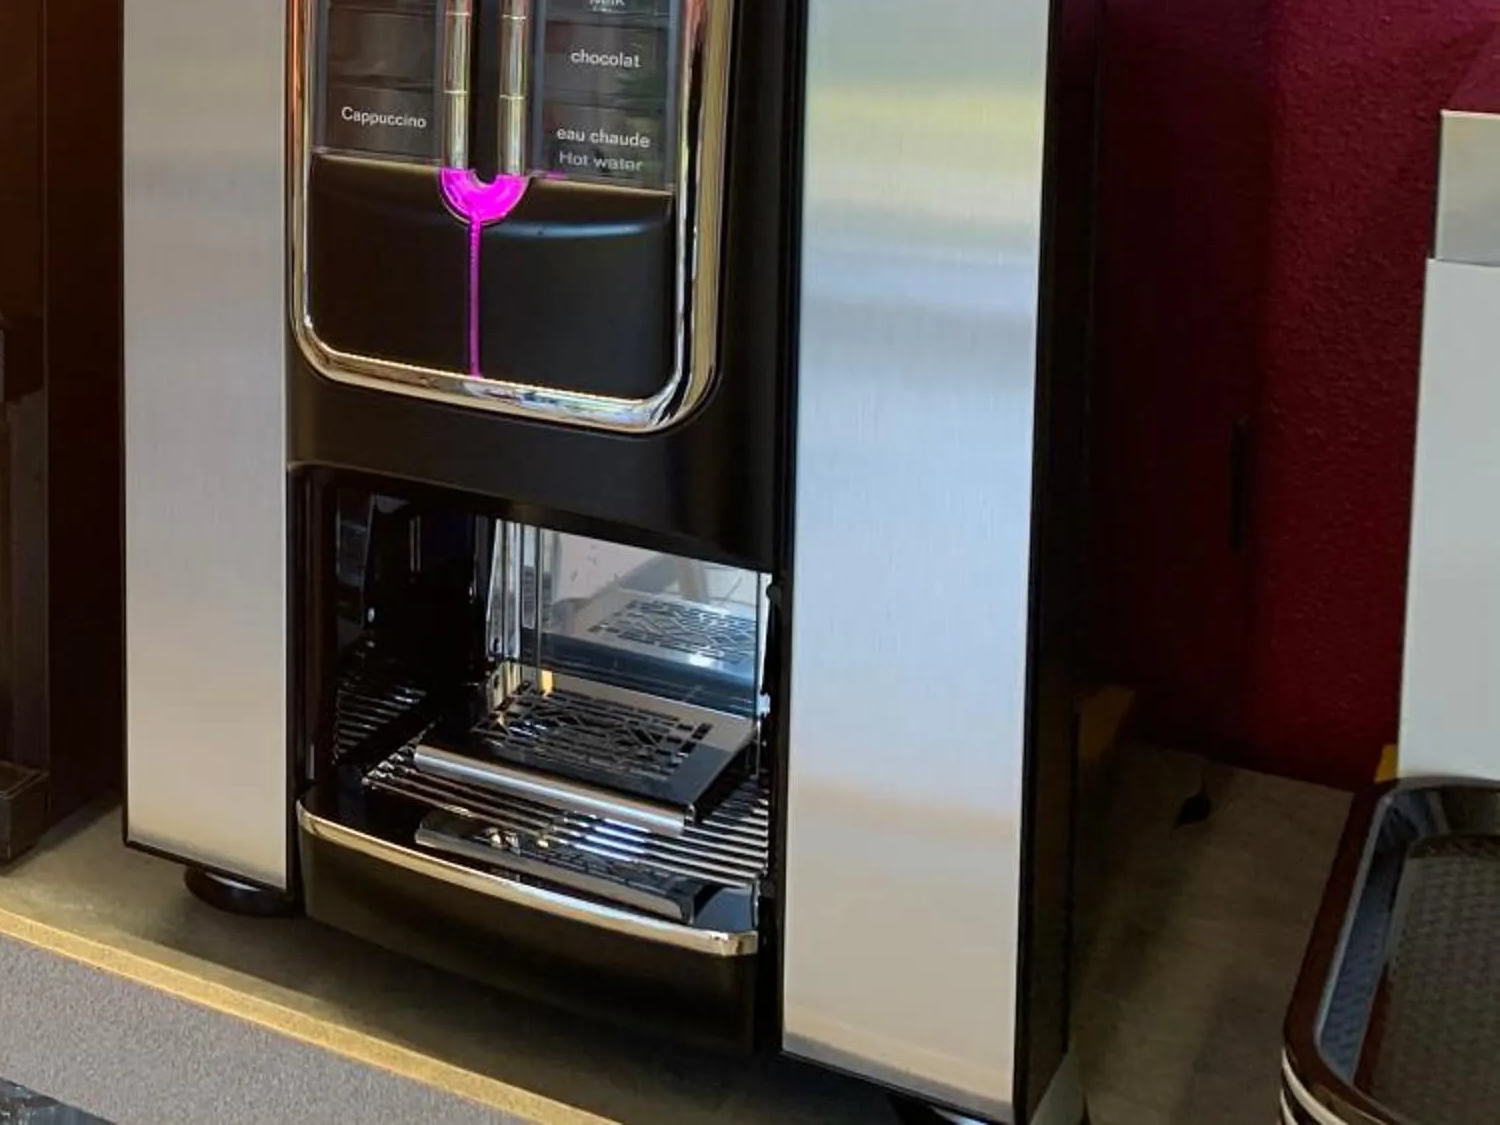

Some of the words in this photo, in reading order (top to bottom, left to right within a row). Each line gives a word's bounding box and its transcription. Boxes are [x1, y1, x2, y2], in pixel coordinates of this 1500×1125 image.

[571, 49, 641, 68] chocolat
[341, 106, 427, 129] Cappuccino
[557, 129, 585, 143] eau
[589, 128, 651, 149] chaude
[559, 151, 588, 168] Hot
[593, 154, 644, 172] water
